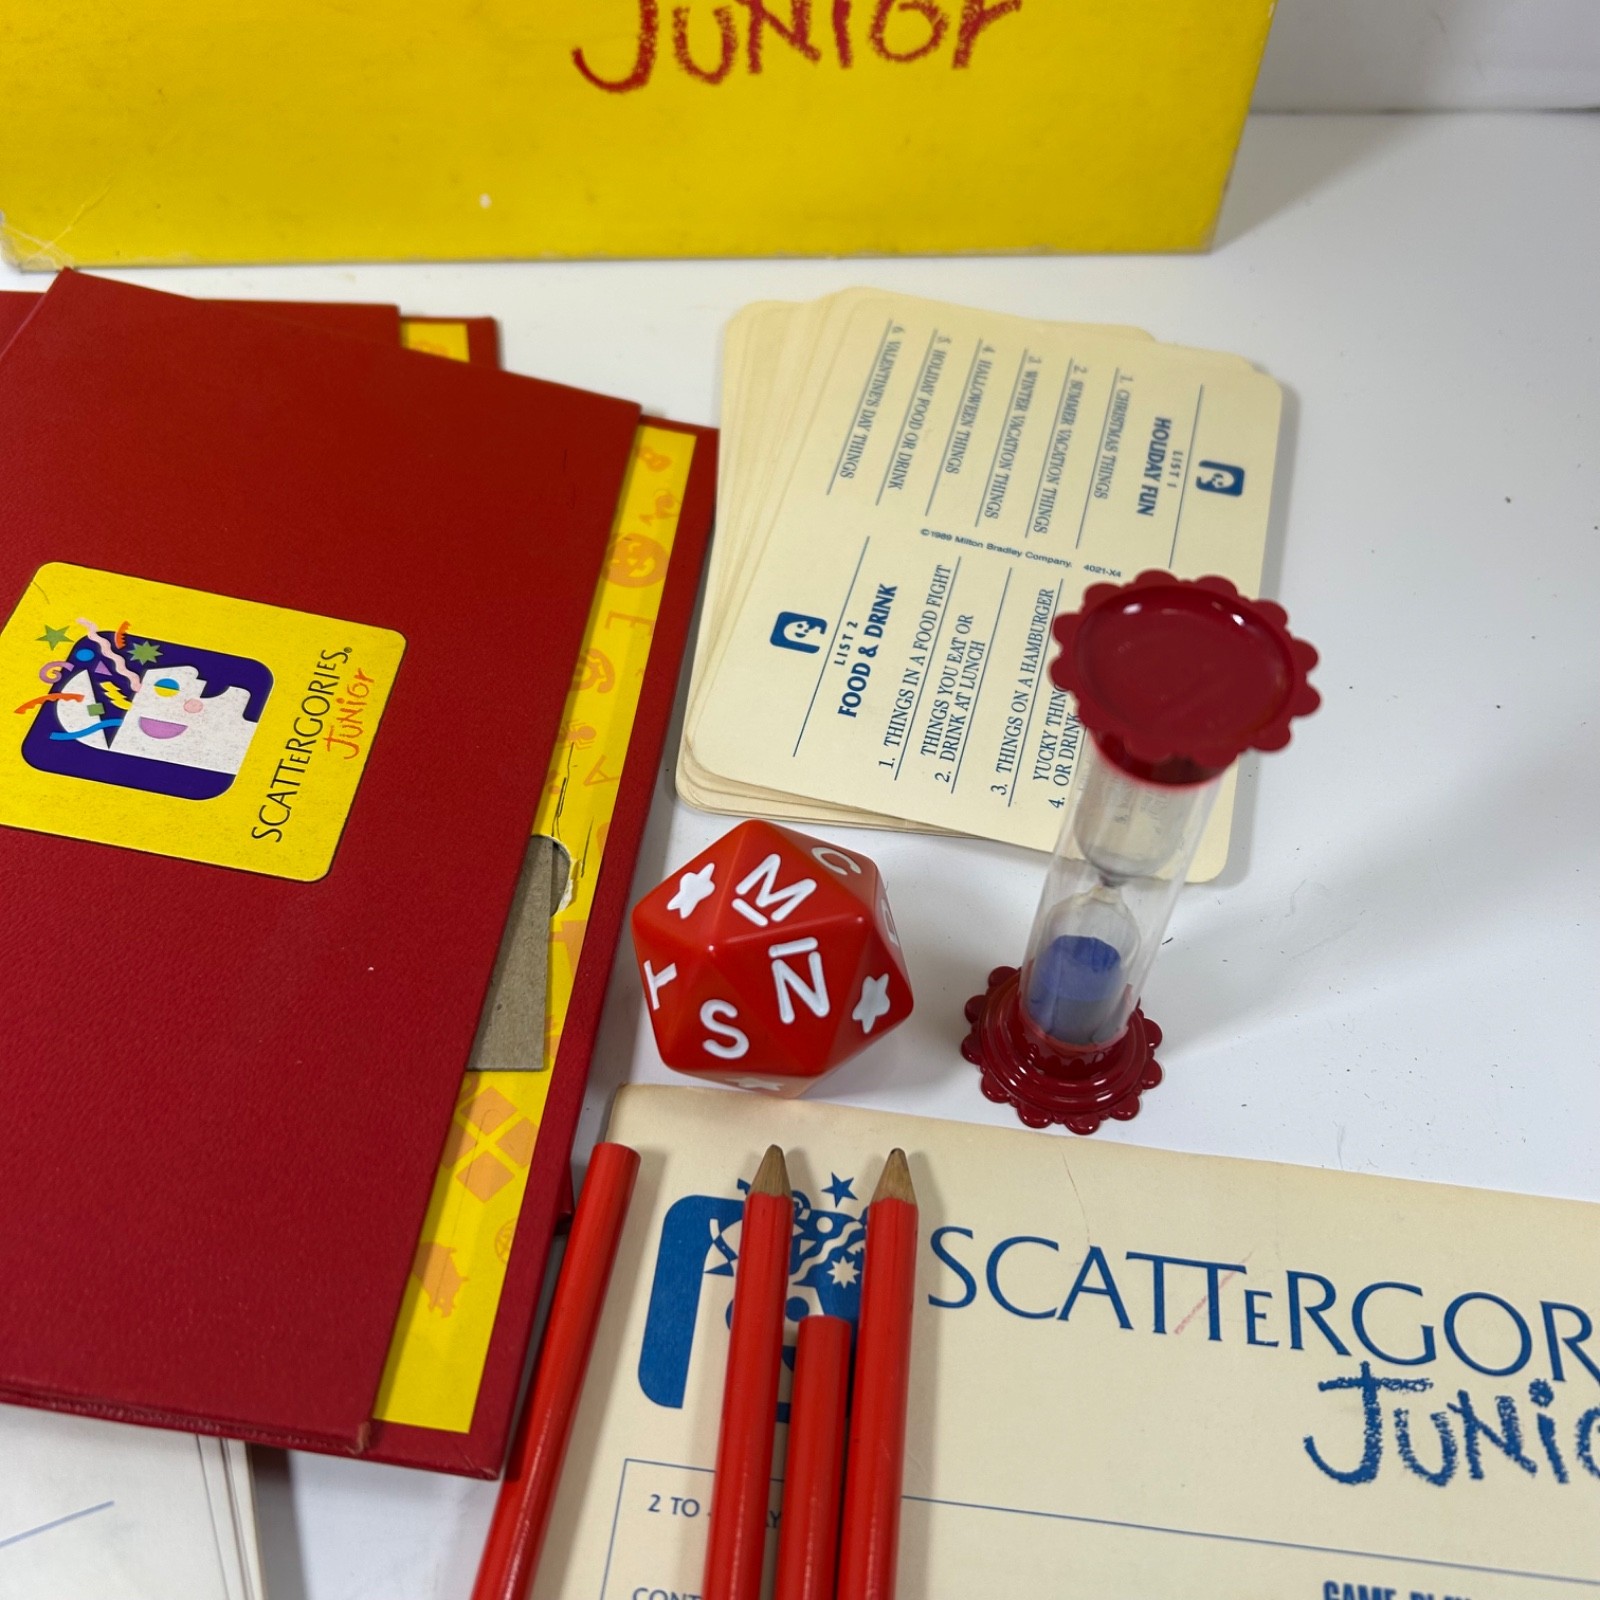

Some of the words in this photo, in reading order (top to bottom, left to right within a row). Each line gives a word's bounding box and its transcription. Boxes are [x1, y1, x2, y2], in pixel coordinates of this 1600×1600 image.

[921, 350, 947, 396] HOLIDAY
[960, 359, 992, 428] HALLOWEEN
[1014, 370, 1038, 412] WINTER
[857, 410, 876, 433] DAY
[909, 398, 930, 431] FOOD
[1060, 380, 1084, 426] SUMMER
[1104, 389, 1130, 453] CHRISTMAS
[840, 433, 867, 479] THINGS
[901, 432, 919, 451] OR
[945, 430, 971, 474] THINGS
[999, 415, 1026, 471] VACATION
[1044, 427, 1072, 486] VACATION
[1144, 416, 1172, 484] HOLIDAY
[888, 452, 913, 490] DRINK
[1094, 454, 1116, 500] THINGS
[1169, 450, 1184, 478] LIST
[984, 473, 1009, 519] THINGS
[1033, 486, 1058, 534] THINGS
[1136, 484, 1159, 517] FUN
[954, 536, 984, 548] Milton
[986, 542, 1023, 558] Bradley
[926, 564, 951, 608] FIGHT
[864, 583, 898, 639] DRINK
[912, 610, 938, 652] FOOD
[955, 614, 974, 636] OR
[1020, 588, 1055, 675] HAMBURGER
[834, 634, 854, 666] LIST
[846, 621, 859, 629] 2
[858, 644, 879, 658] &
[909, 654, 926, 666] A
[947, 637, 967, 665] EAT
[959, 640, 986, 691] LUNCH
[837, 662, 871, 718] FOOD
[902, 668, 921, 686] IN
[937, 666, 959, 696] YOU
[1017, 678, 1034, 689] A
[883, 689, 915, 748] THINGS
[954, 692, 971, 712] AT
[1010, 690, 1031, 714] ON
[920, 700, 950, 756] THINGS
[939, 713, 966, 763] DRINK
[996, 717, 1024, 774] THINGS
[878, 757, 896, 769] 1.
[934, 770, 952, 783] 2.
[1032, 730, 1059, 782] YUCKY
[1052, 760, 1073, 787] OR
[990, 782, 1008, 796] 3.
[1048, 796, 1066, 809] 4.
[732, 853, 817, 926] M
[700, 999, 749, 1059] S
[648, 1494, 661, 1512] 2
[670, 1497, 700, 1517] TO
